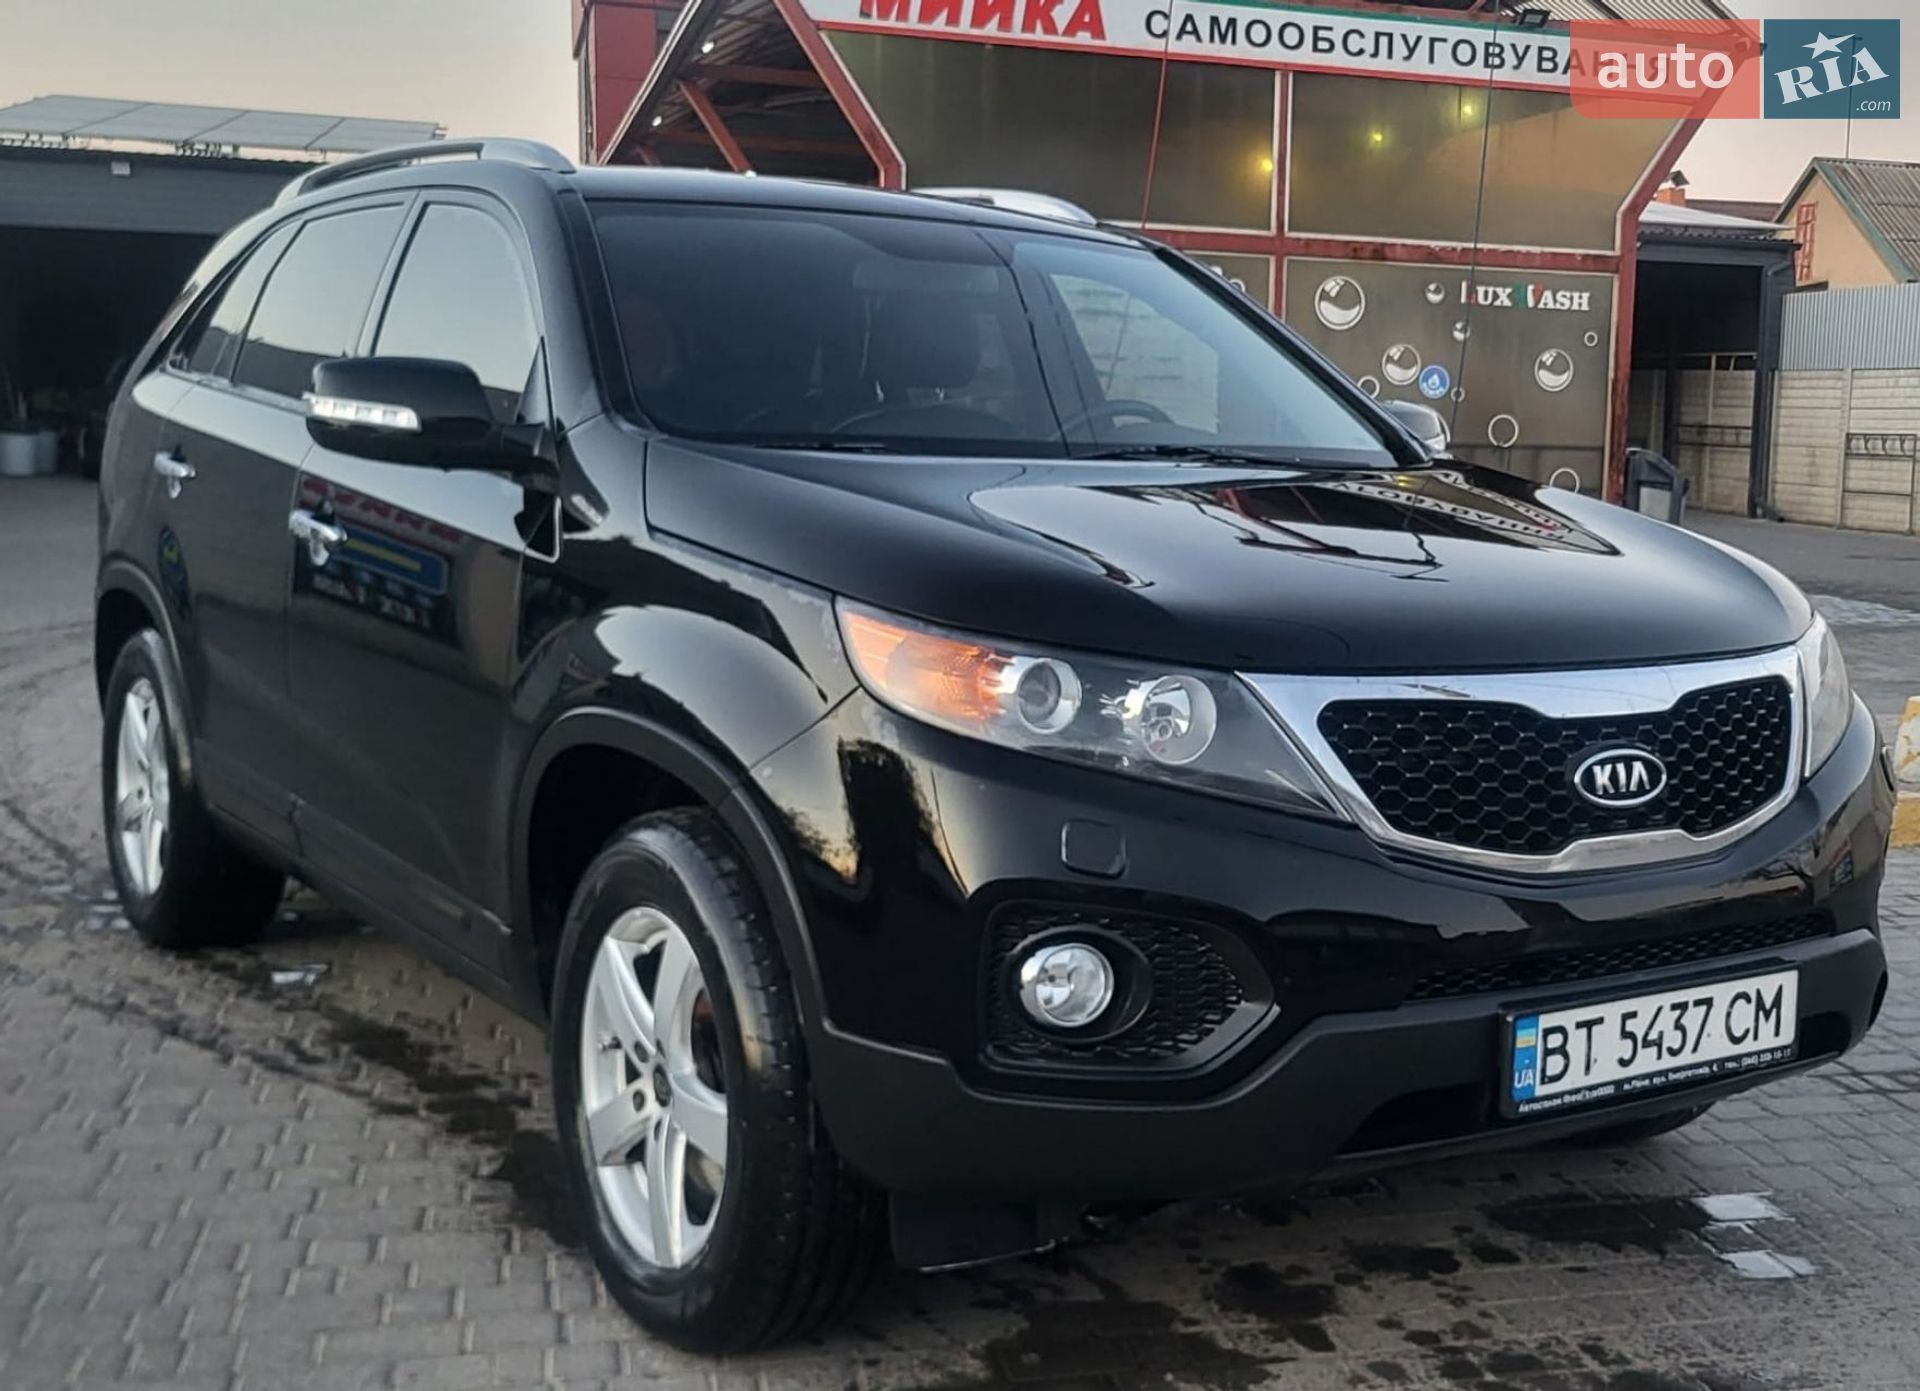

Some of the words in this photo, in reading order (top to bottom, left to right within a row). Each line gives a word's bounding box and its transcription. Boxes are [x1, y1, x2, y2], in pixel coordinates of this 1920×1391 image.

[1592, 761, 1651, 795] KIA
[1539, 1016, 1604, 1086] BT
[1617, 996, 1714, 1068] 5437
[1725, 984, 1783, 1046] CM
[1514, 1069, 1534, 1088] UA
